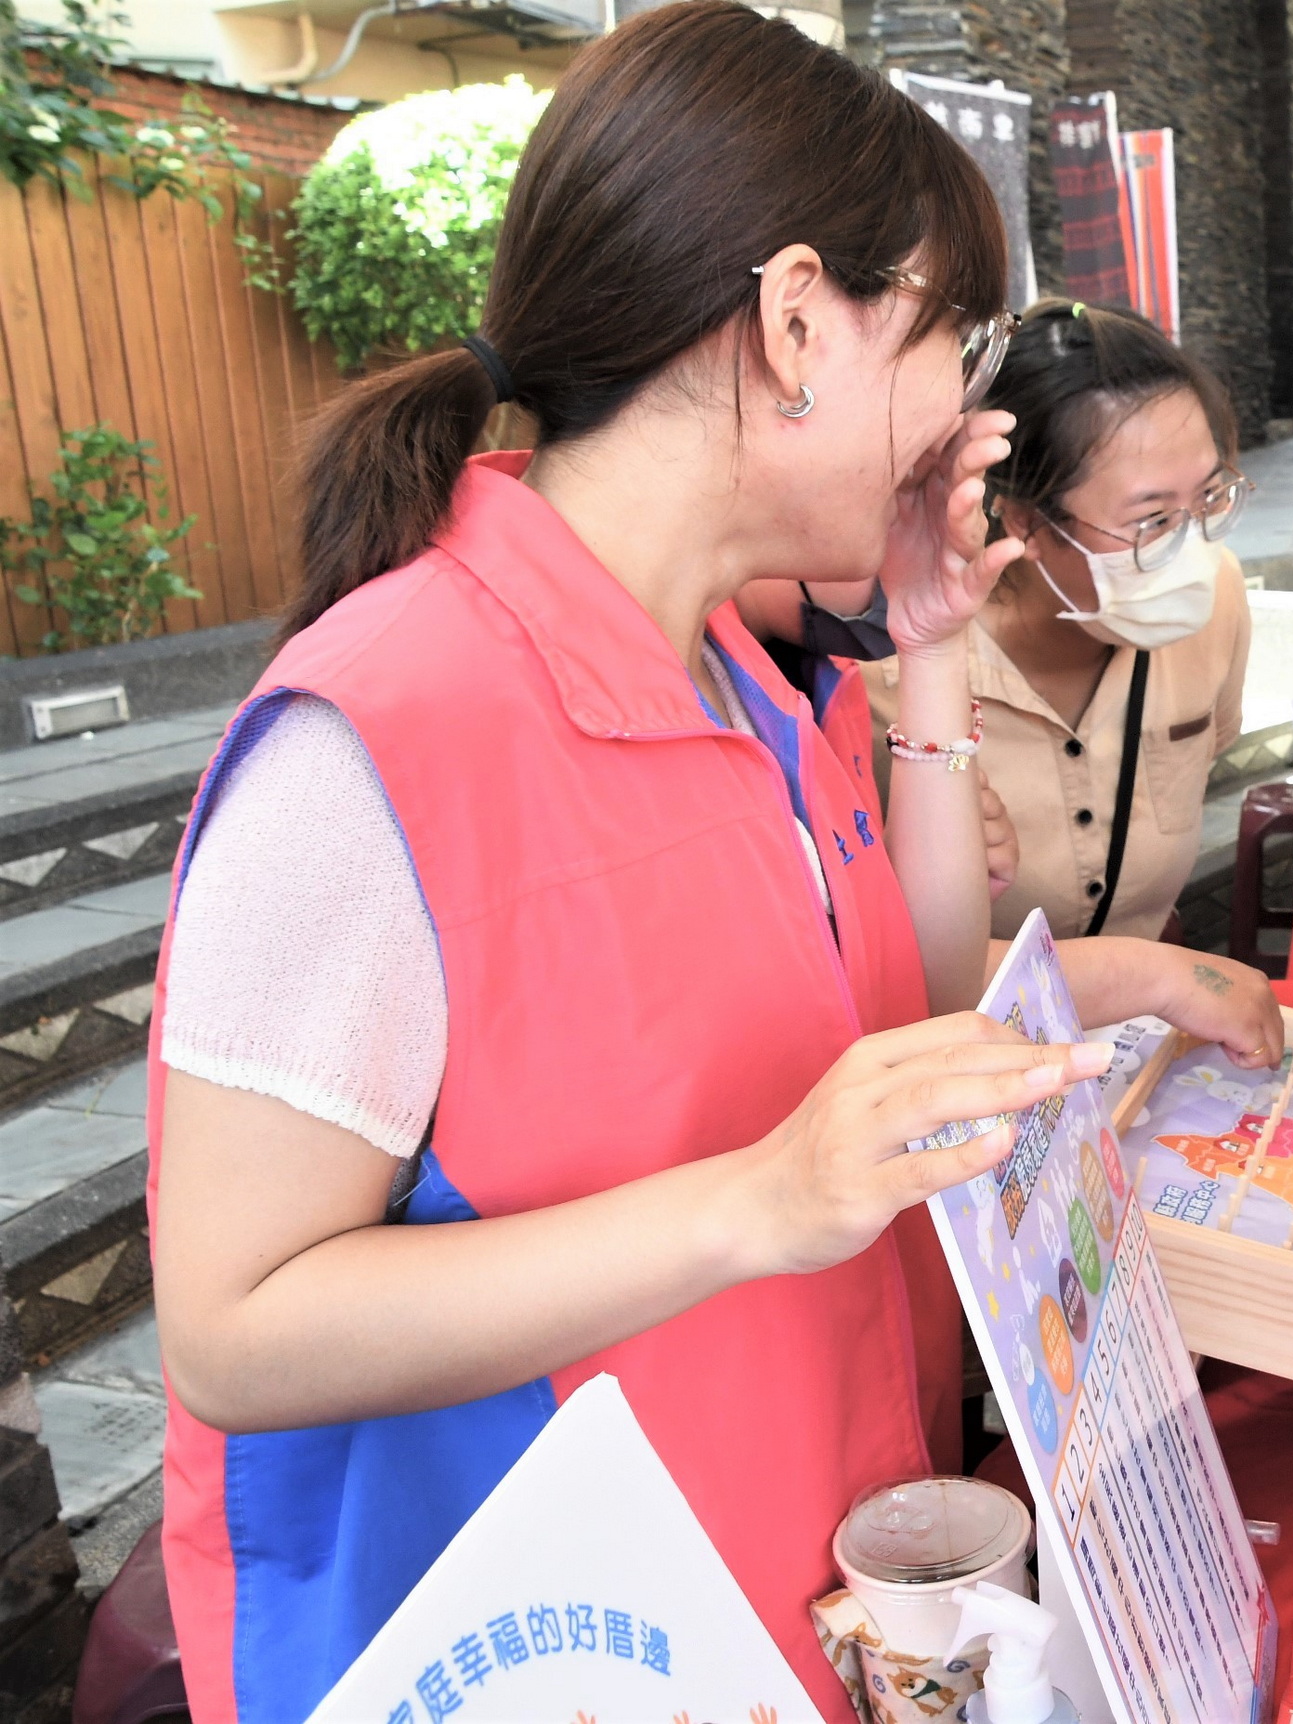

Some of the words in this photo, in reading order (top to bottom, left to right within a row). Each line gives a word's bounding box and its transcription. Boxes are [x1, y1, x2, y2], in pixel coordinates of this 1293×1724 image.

[1131, 1202, 1146, 1240] 10
[1126, 1229, 1138, 1262] 9
[1118, 1254, 1131, 1287] 8
[1111, 1280, 1124, 1318] 7
[1105, 1310, 1118, 1346] 6
[1097, 1338, 1110, 1377] 5
[1089, 1371, 1103, 1410] 4
[1079, 1408, 1094, 1446] 3
[1071, 1449, 1085, 1482] 2
[1062, 1491, 1076, 1527] 1
